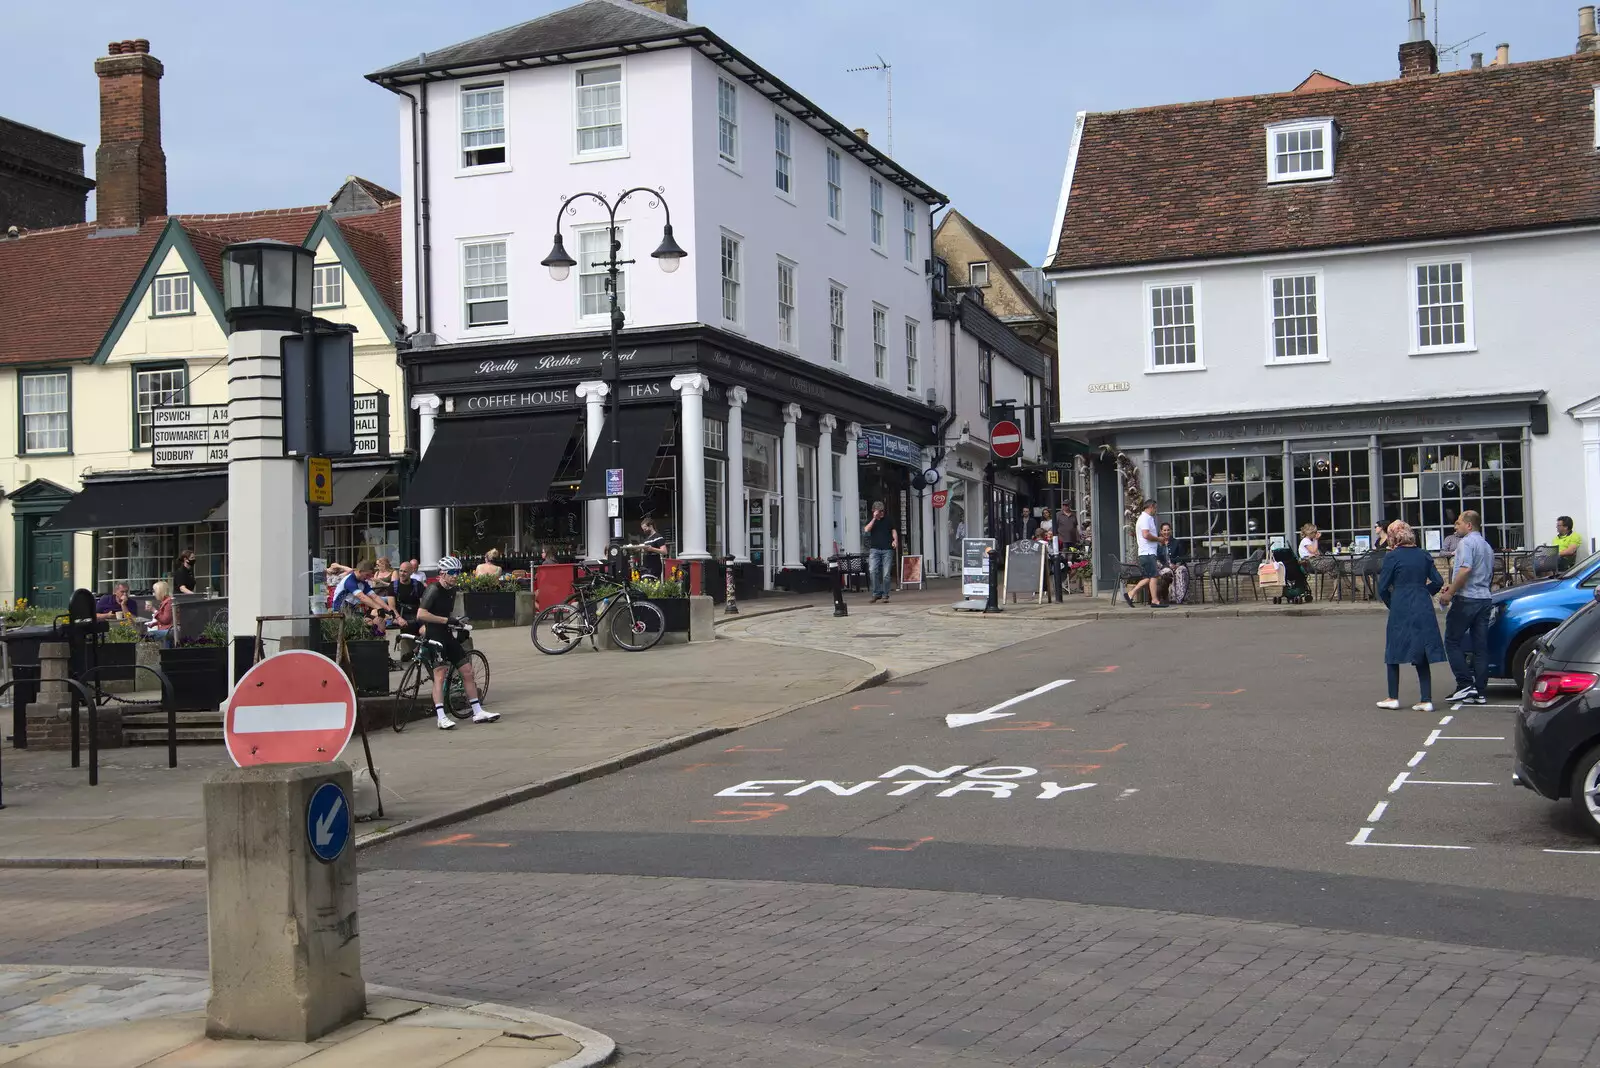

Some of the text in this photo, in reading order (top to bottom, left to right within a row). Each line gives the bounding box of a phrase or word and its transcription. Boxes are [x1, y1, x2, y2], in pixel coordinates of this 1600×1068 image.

[475, 360, 518, 374] Really
[535, 354, 582, 370] Rather
[628, 383, 660, 397] TEAS
[468, 390, 569, 410] COFFEE HOUSE
[156, 410, 191, 422] IPSWICH
[155, 429, 208, 442] STOWMARKET
[156, 449, 229, 462] SUDBURY A134
[878, 764, 1039, 779] NO
[713, 779, 1098, 799] ENTRY
